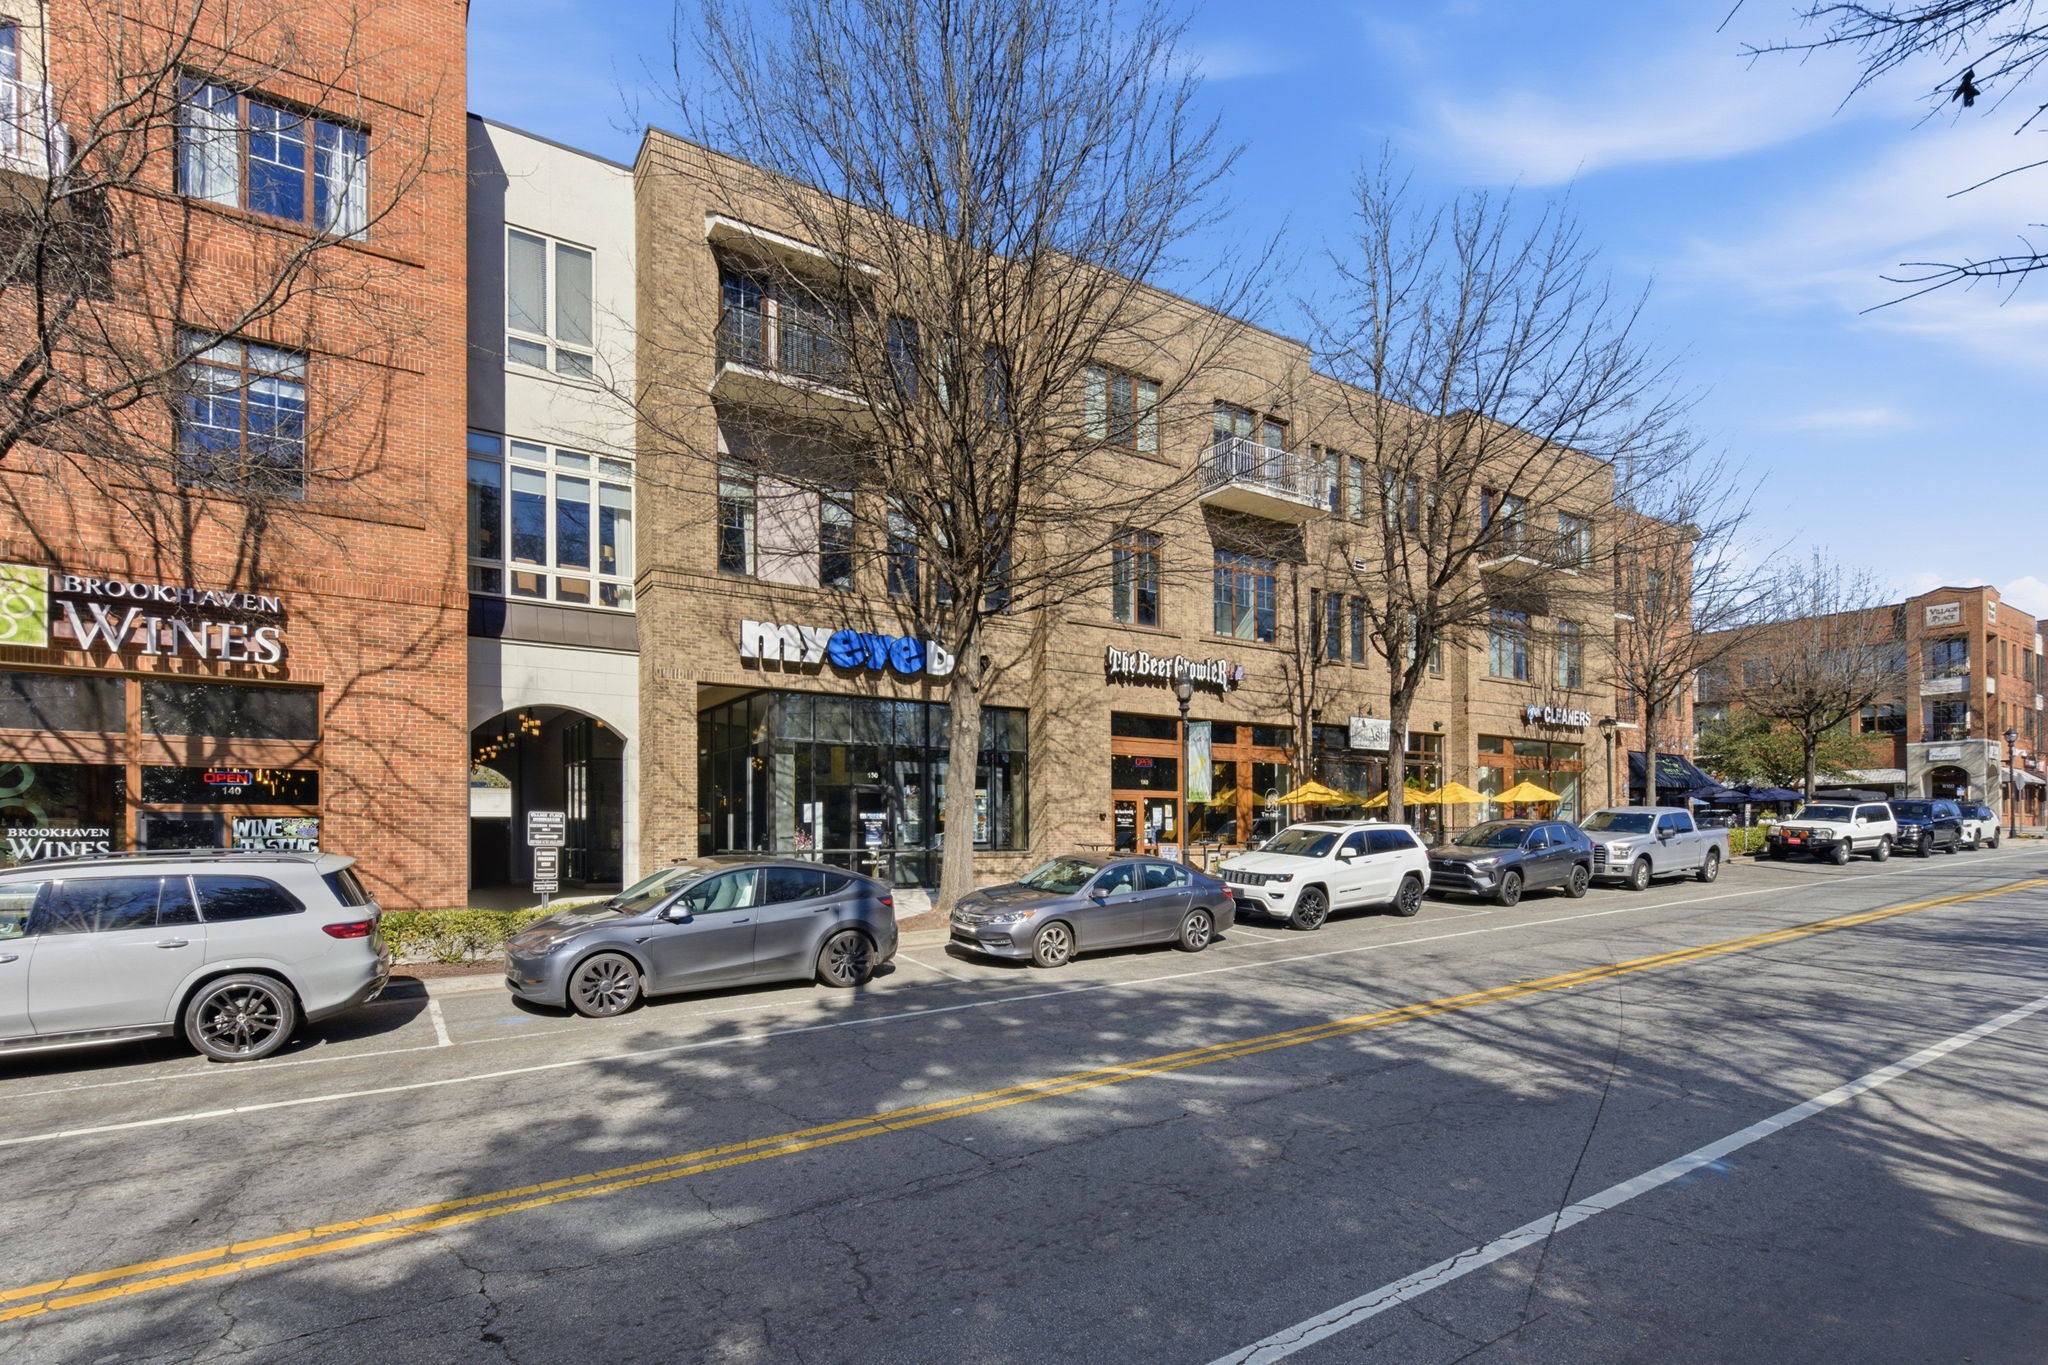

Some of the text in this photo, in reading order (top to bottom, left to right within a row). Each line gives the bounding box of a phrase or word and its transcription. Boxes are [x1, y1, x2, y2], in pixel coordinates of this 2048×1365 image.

[63, 575, 280, 613] BROOKHAVEN
[1930, 606, 1957, 615] VILLAGE
[56, 600, 281, 664] WINES
[1109, 646, 1138, 675] The
[1139, 650, 1173, 678] Beer
[1544, 706, 1592, 727] CLEANERS
[204, 773, 248, 784] OPEN
[222, 786, 242, 795] 140
[7, 828, 110, 837] BROOKHAVEN
[232, 818, 284, 837] WINE
[6, 838, 110, 860] WINES
[241, 838, 320, 853] TASTING
